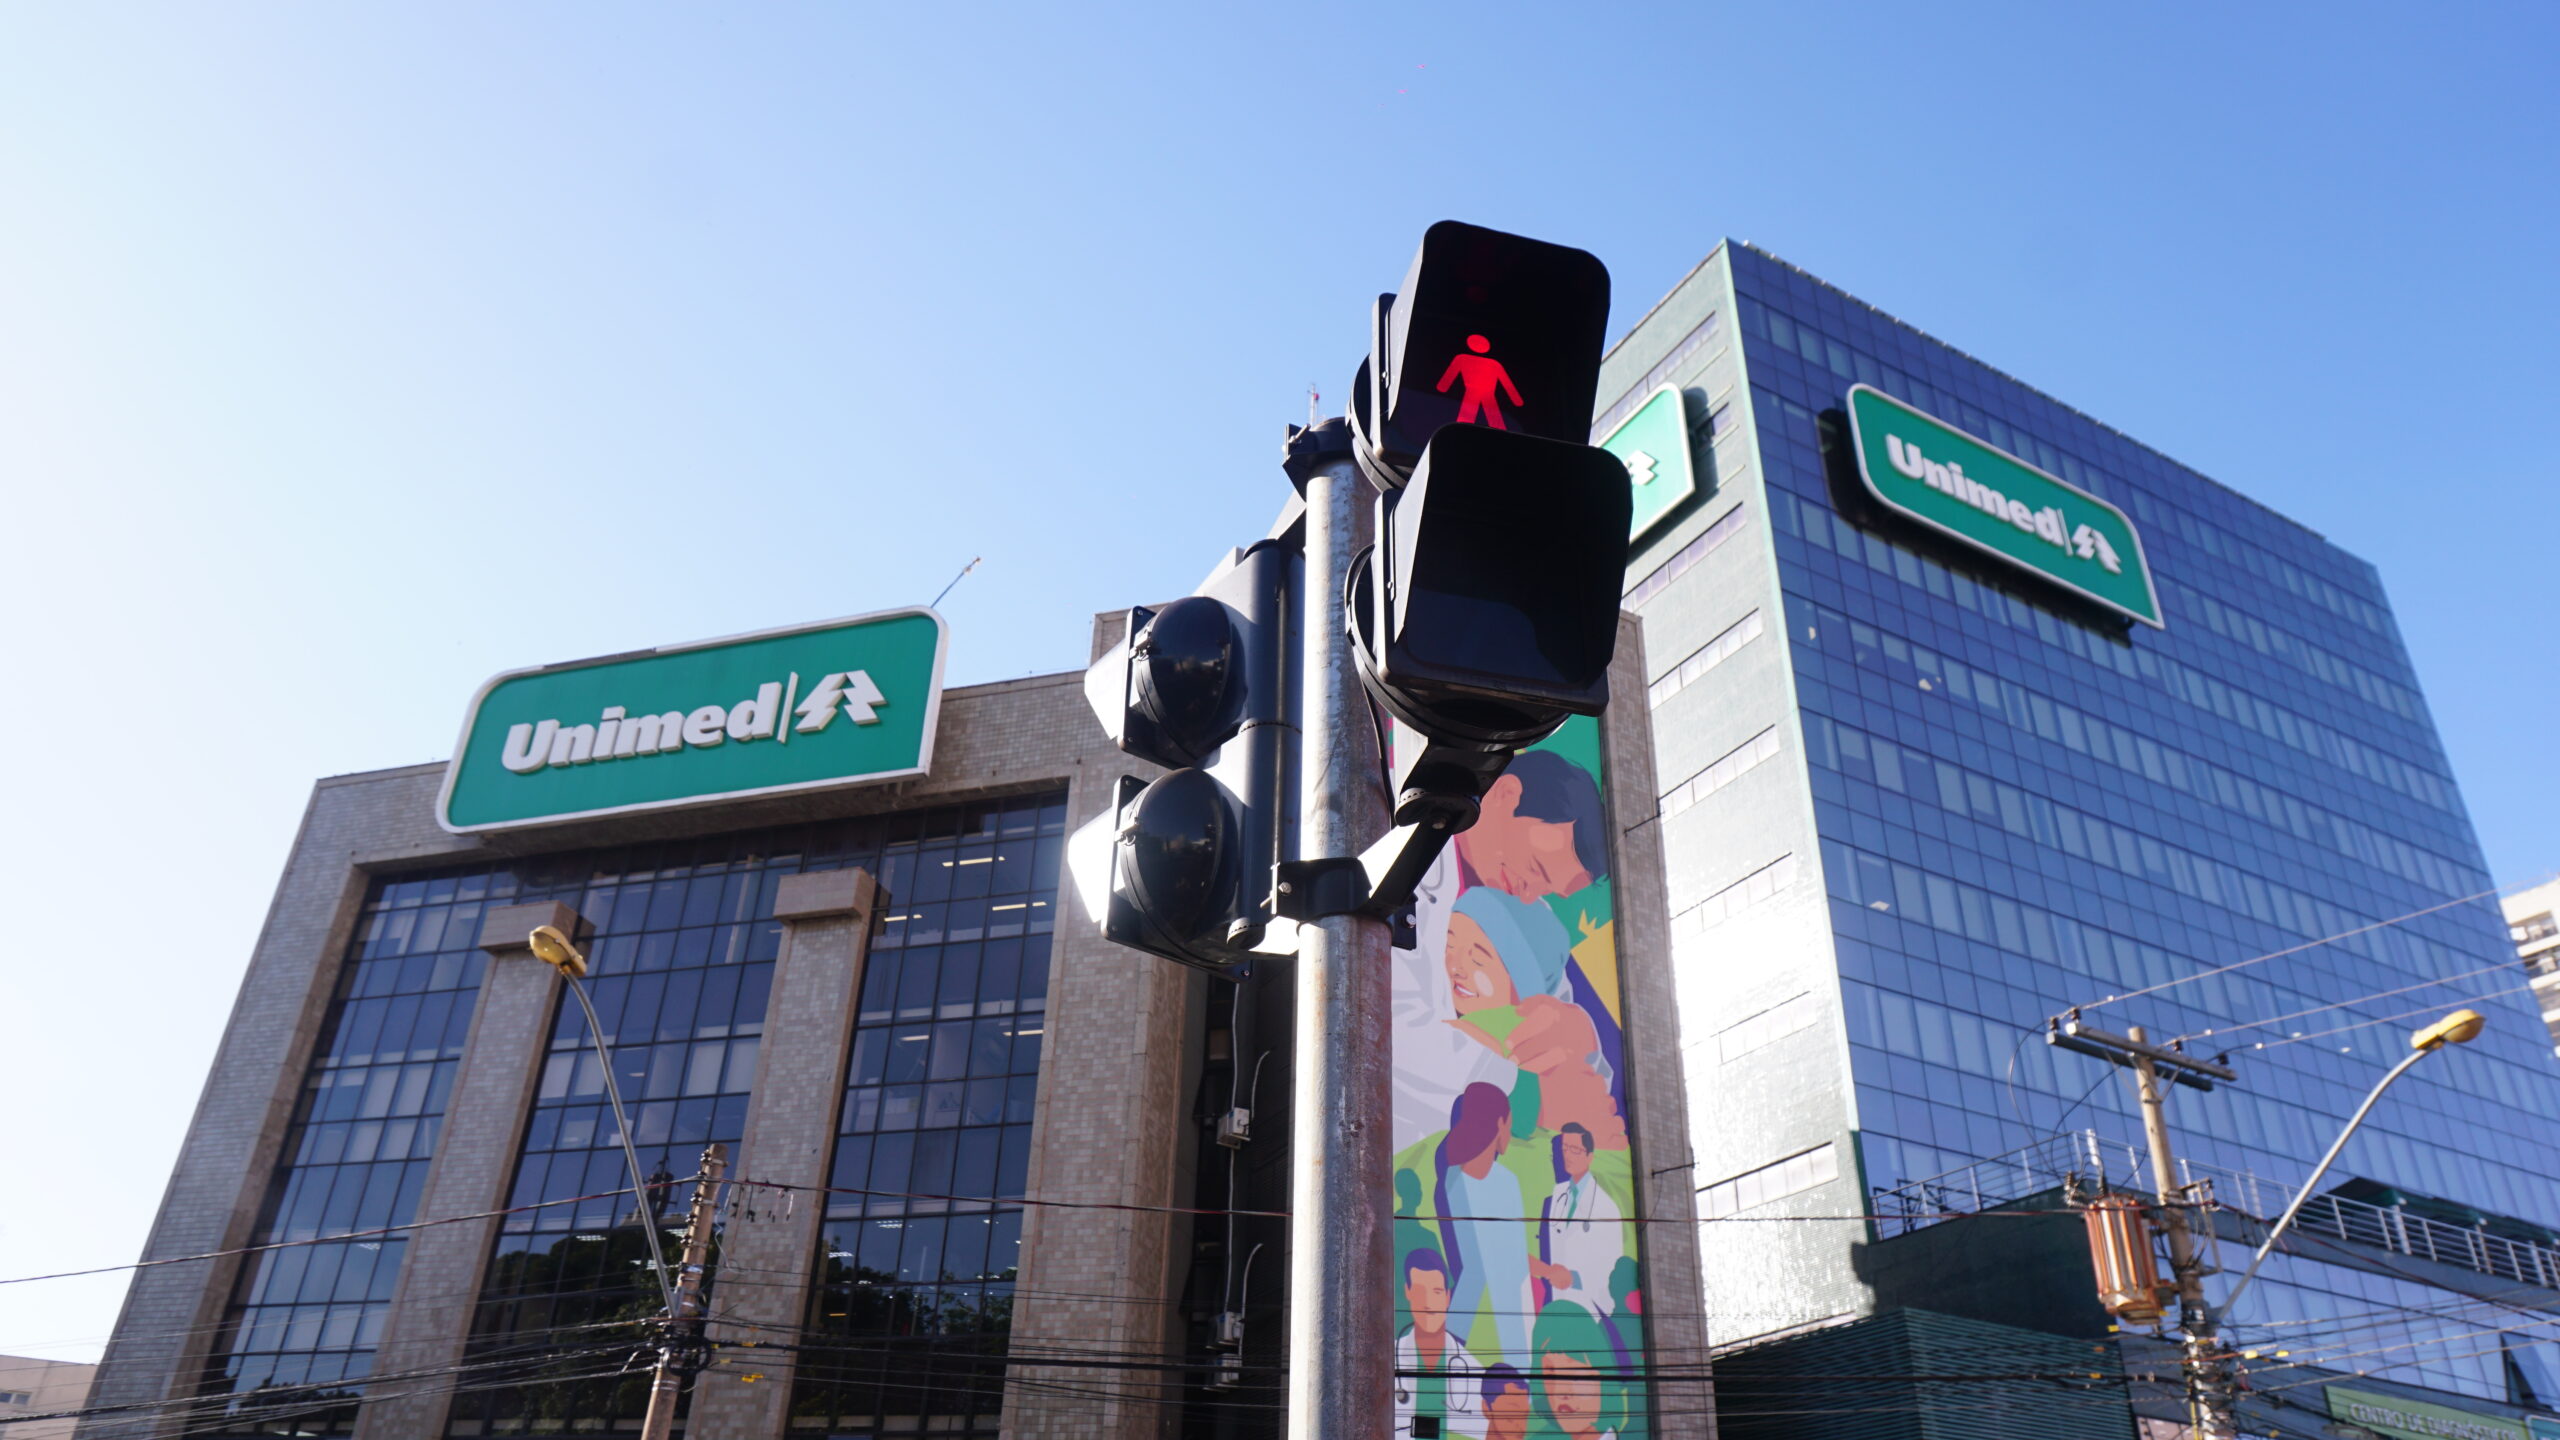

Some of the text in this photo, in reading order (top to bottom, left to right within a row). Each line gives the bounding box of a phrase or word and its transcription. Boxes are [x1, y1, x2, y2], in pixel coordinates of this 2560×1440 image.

[1886, 433, 2064, 546] Unimed
[501, 681, 783, 773] Unimed
[2351, 1404, 2403, 1428] CENTRO
[2408, 1412, 2425, 1433] DE
